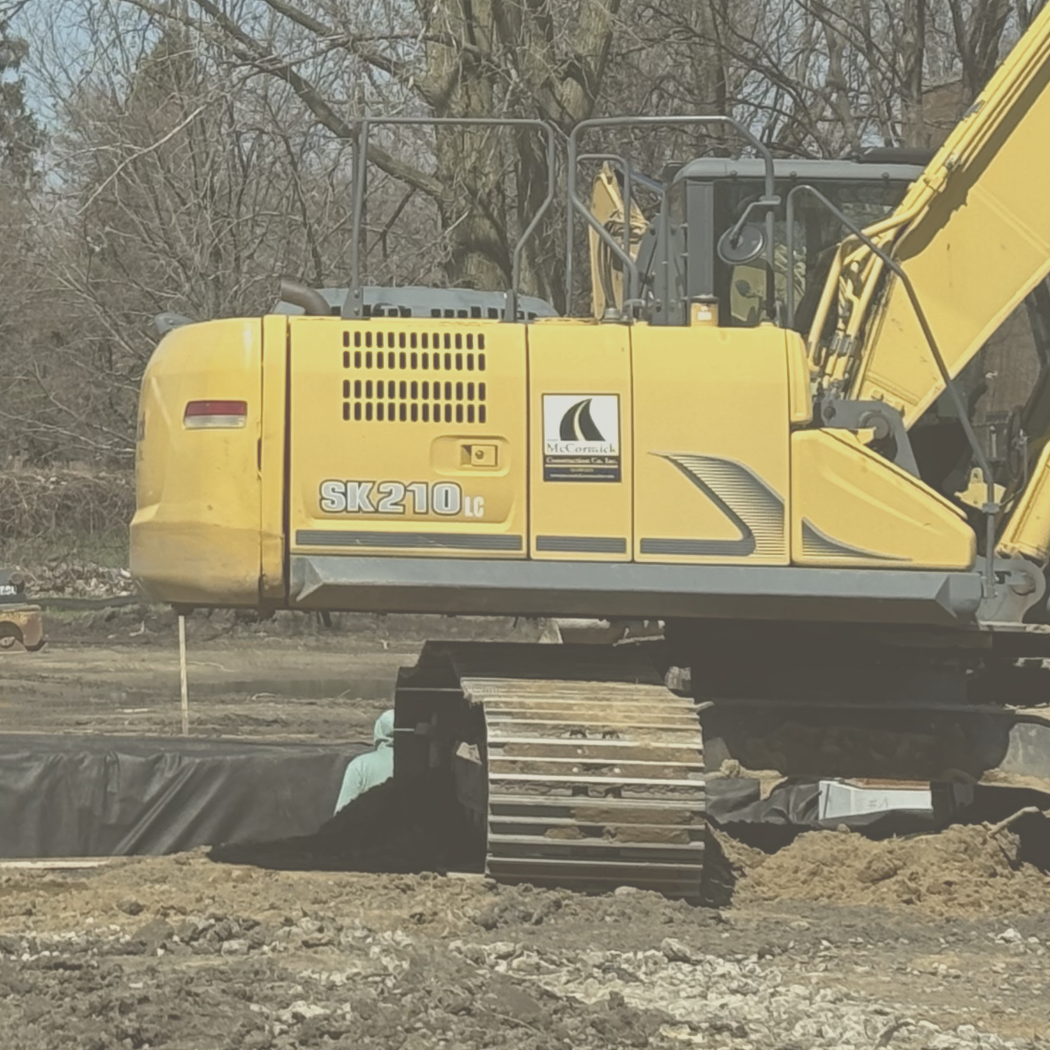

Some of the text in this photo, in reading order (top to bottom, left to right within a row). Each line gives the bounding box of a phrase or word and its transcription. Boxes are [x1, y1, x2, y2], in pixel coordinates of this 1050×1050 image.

[547, 443, 616, 454] McCormick
[320, 480, 484, 518] SK210 LC
